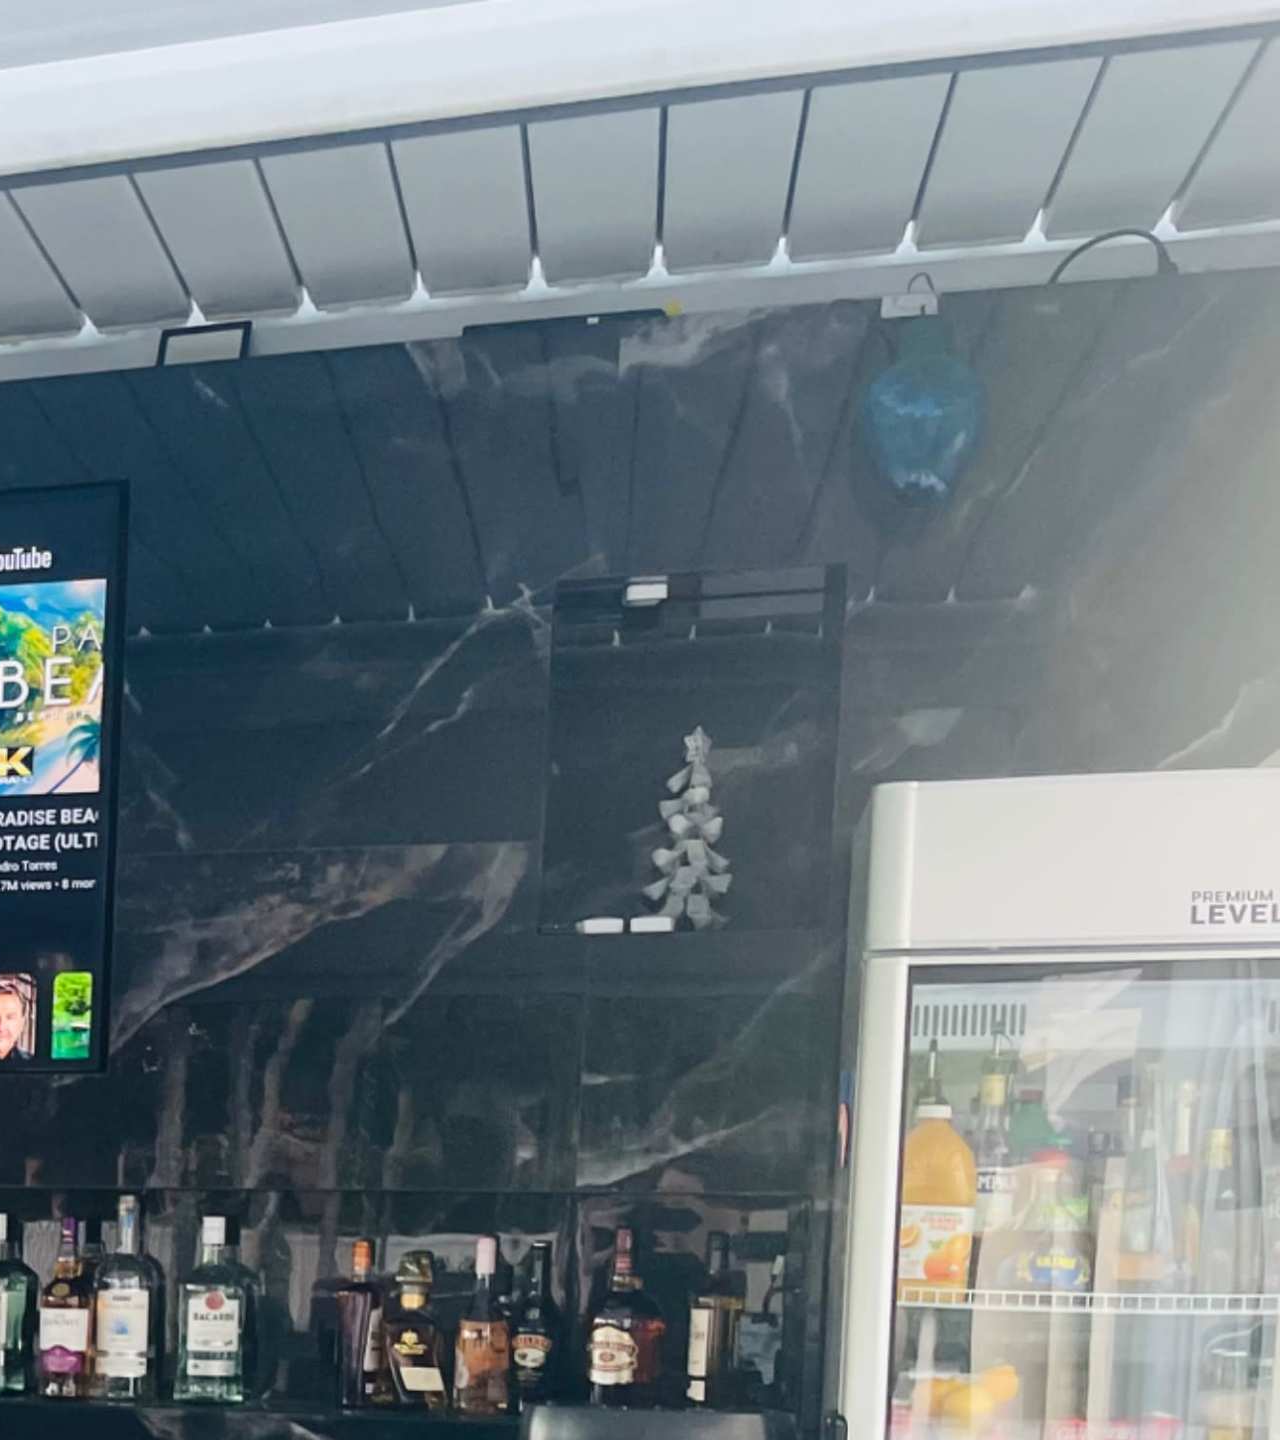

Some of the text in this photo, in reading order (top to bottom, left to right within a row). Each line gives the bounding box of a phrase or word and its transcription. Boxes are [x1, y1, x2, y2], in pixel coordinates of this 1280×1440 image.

[54, 832, 98, 852] (ULT
[22, 861, 58, 871] Torres
[20, 879, 53, 890] views
[1191, 889, 1273, 903] PREMIUM
